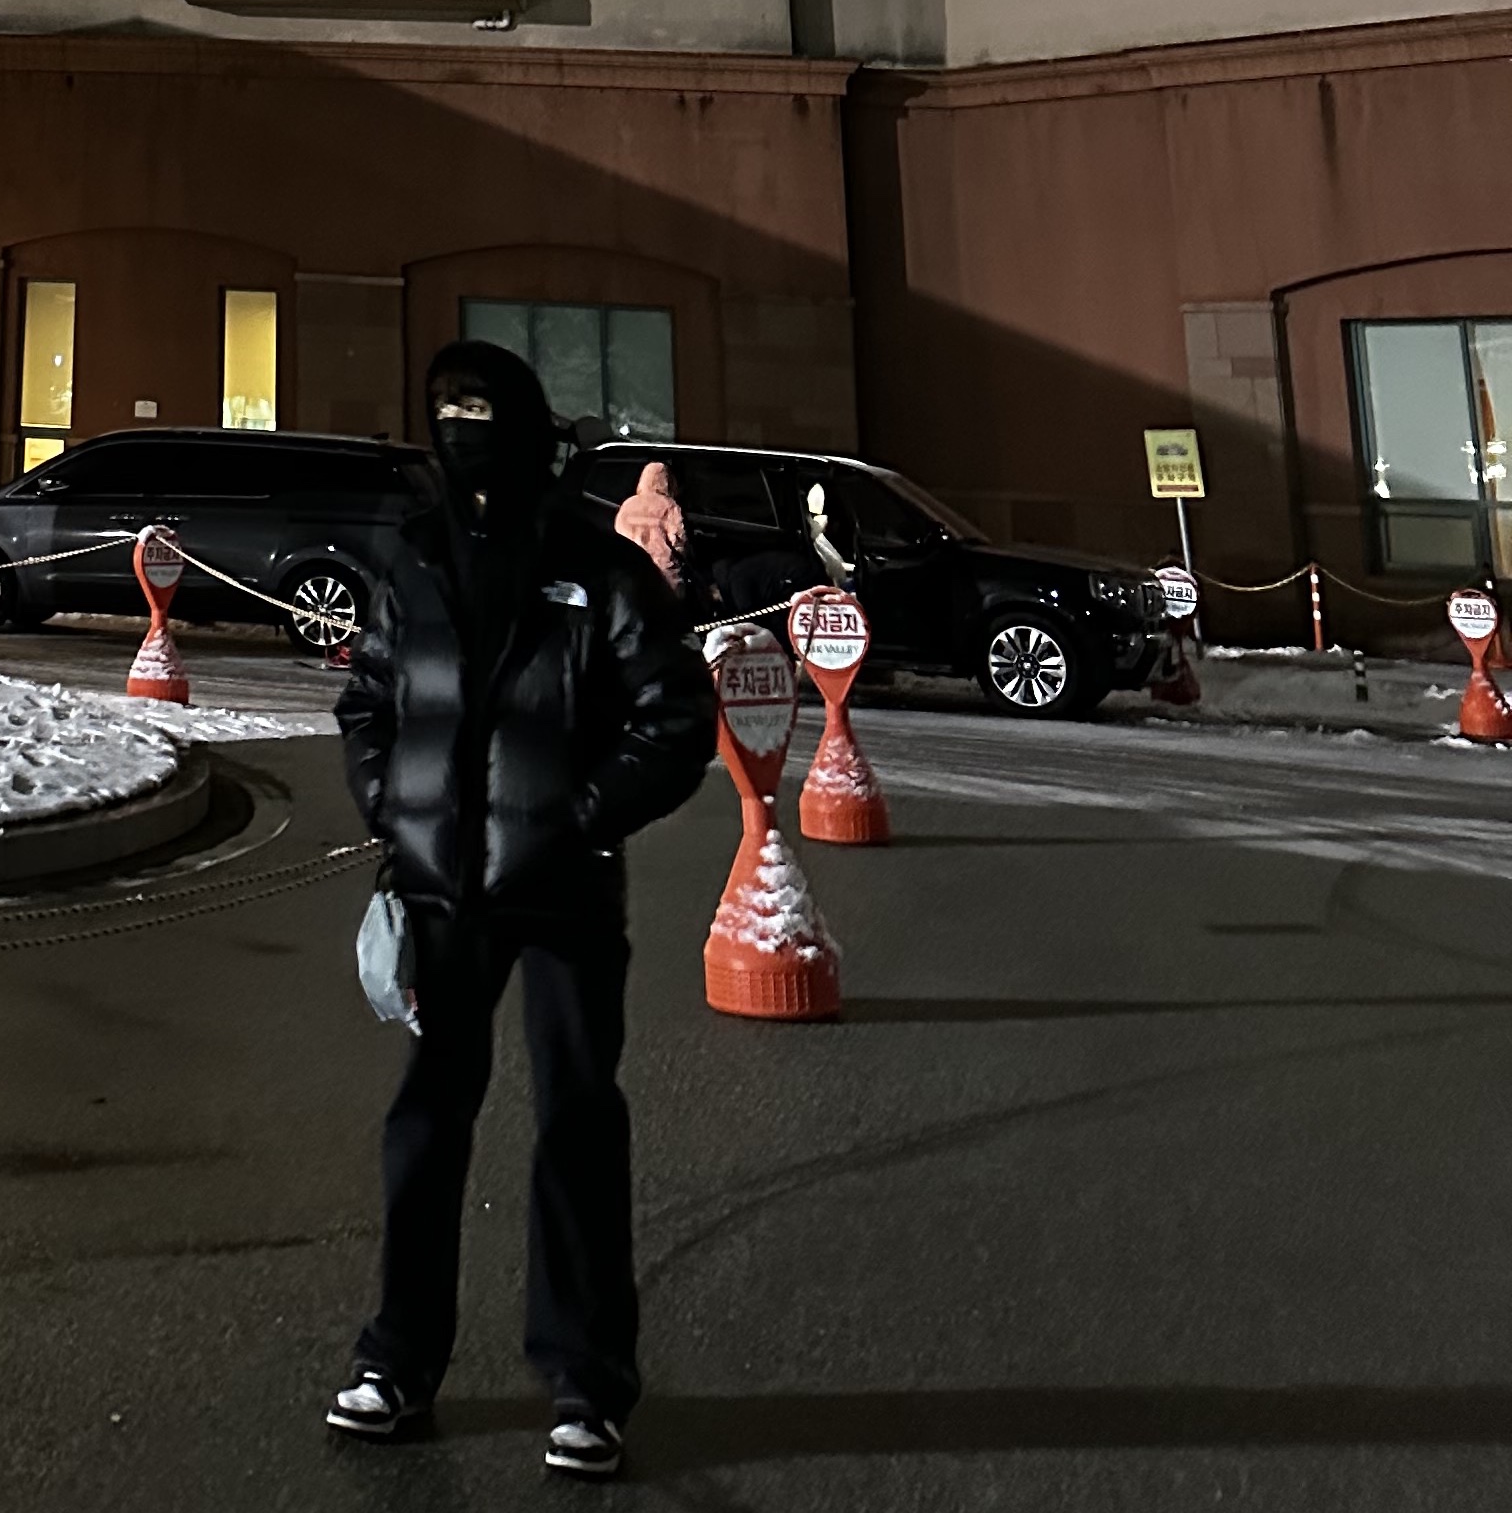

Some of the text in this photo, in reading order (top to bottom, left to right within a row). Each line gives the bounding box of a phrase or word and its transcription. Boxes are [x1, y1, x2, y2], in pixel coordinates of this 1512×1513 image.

[1455, 602, 1491, 616] 주차금지
[798, 612, 858, 634] 주차금지
[823, 643, 859, 655] VALLEY
[726, 664, 787, 697] 주차금지
